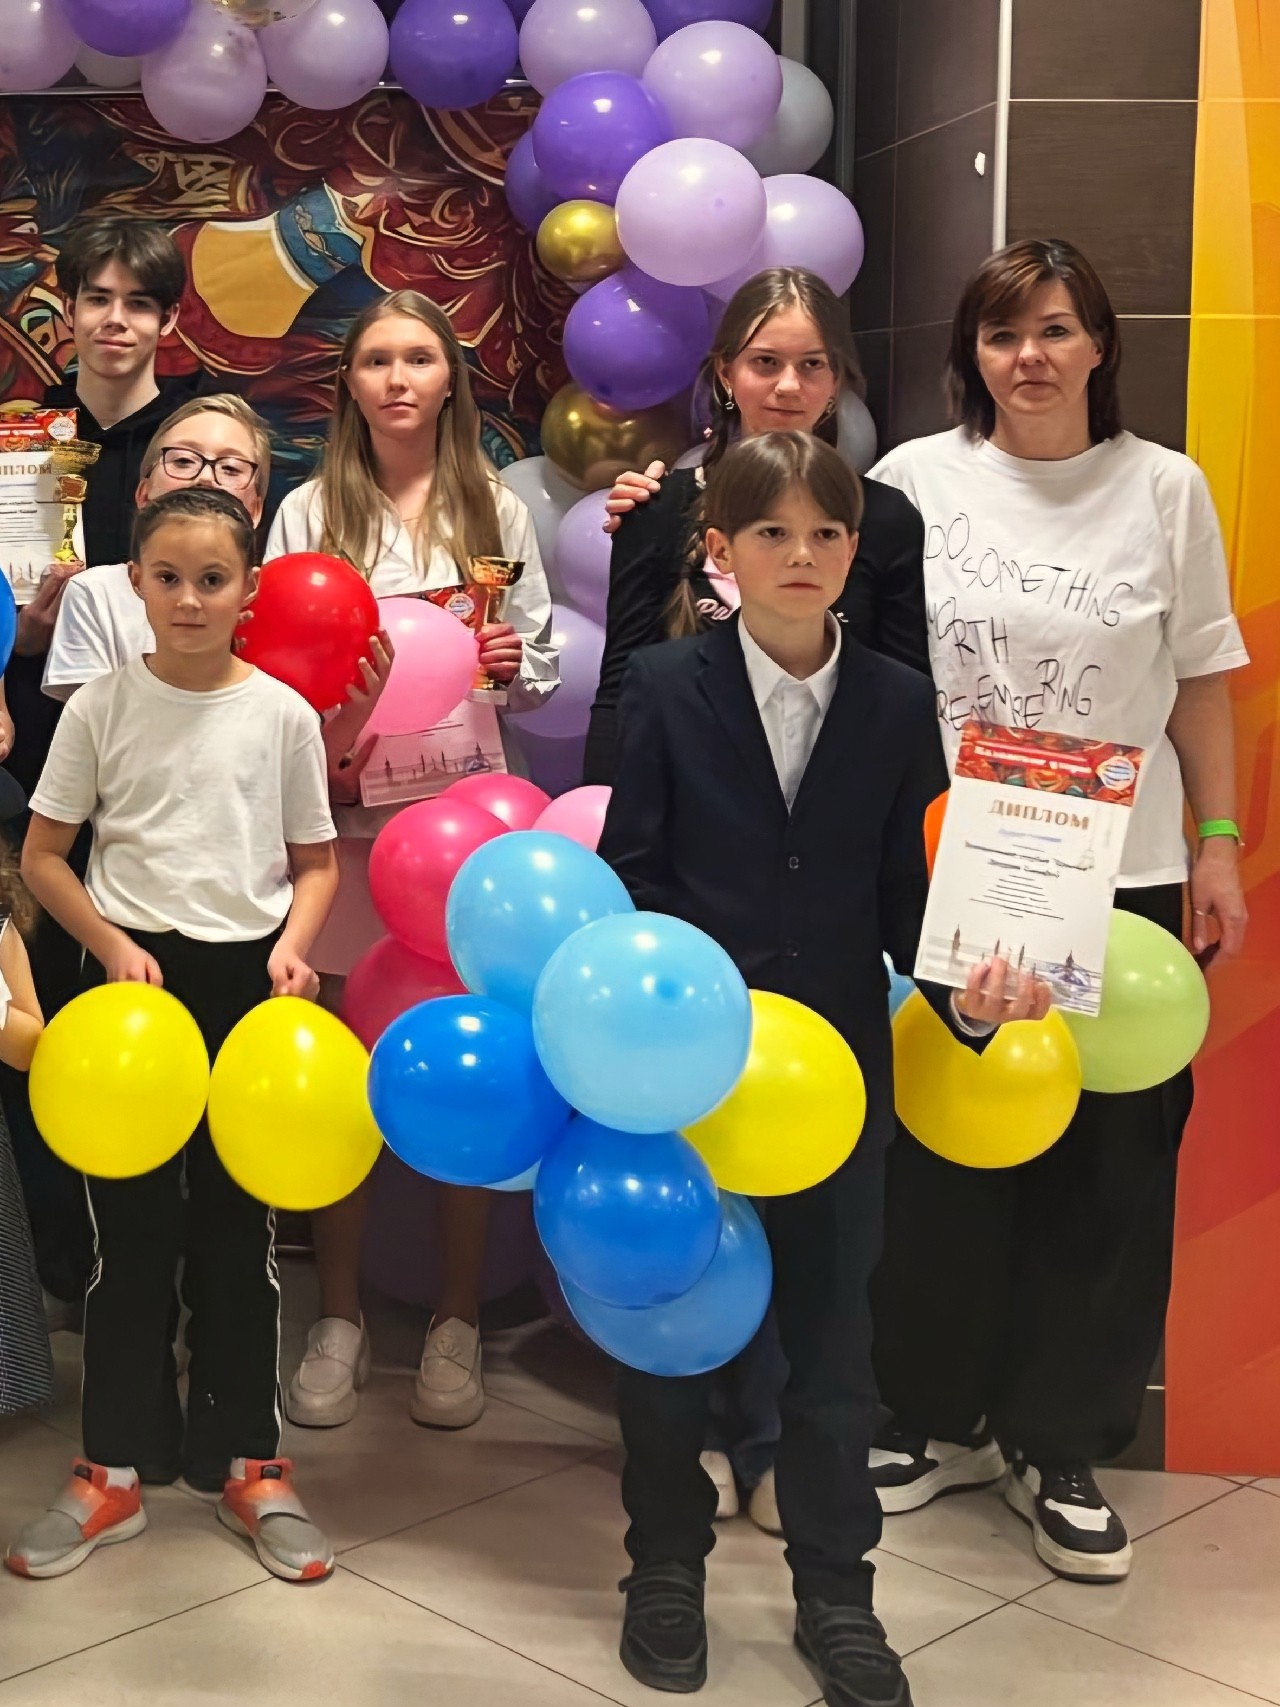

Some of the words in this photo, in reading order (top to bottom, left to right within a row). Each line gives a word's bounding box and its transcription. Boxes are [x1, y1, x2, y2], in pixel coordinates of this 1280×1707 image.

[925, 512, 970, 560] DO
[961, 547, 1134, 627] SOMETHING
[988, 800, 1090, 830] ДИПЛОМ
